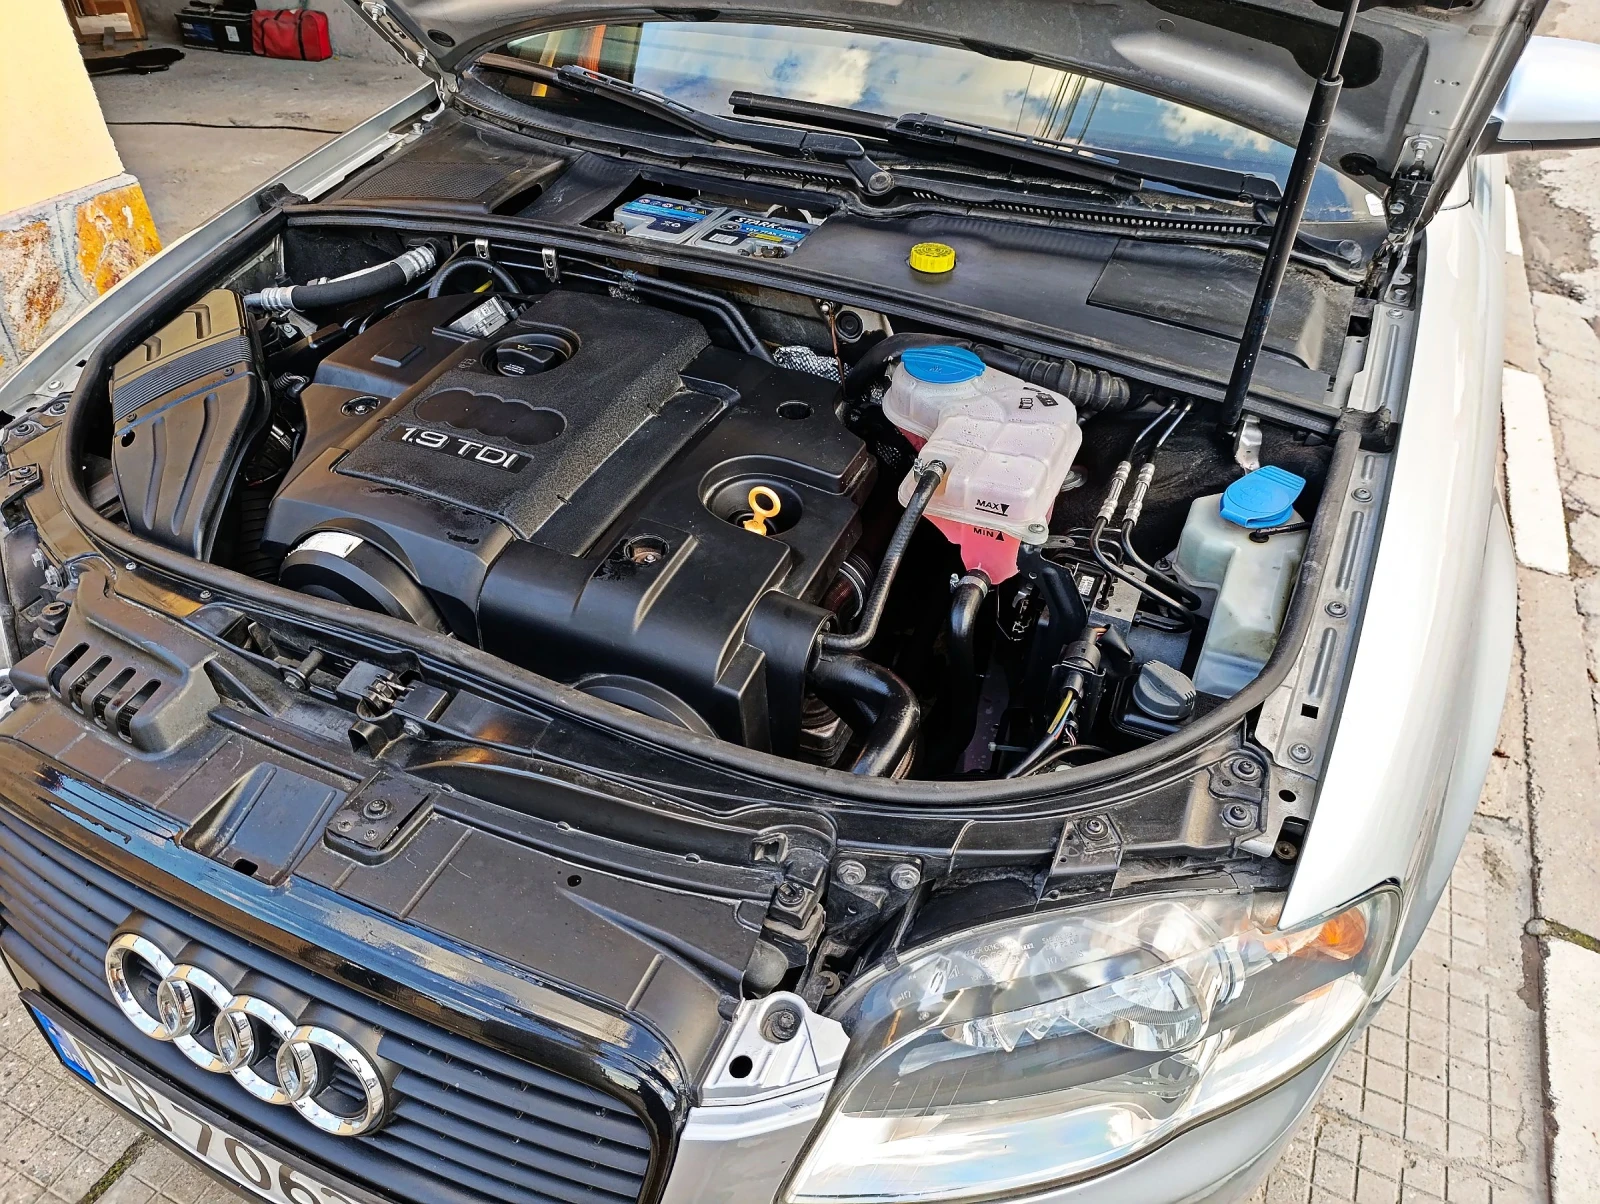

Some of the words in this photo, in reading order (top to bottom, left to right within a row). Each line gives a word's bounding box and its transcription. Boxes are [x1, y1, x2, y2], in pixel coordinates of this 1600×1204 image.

[734, 217, 781, 229] STARK
[457, 438, 519, 469] TDI
[976, 498, 1000, 511] MAX
[973, 527, 994, 538] MIN
[170, 1103, 353, 1204] 706
